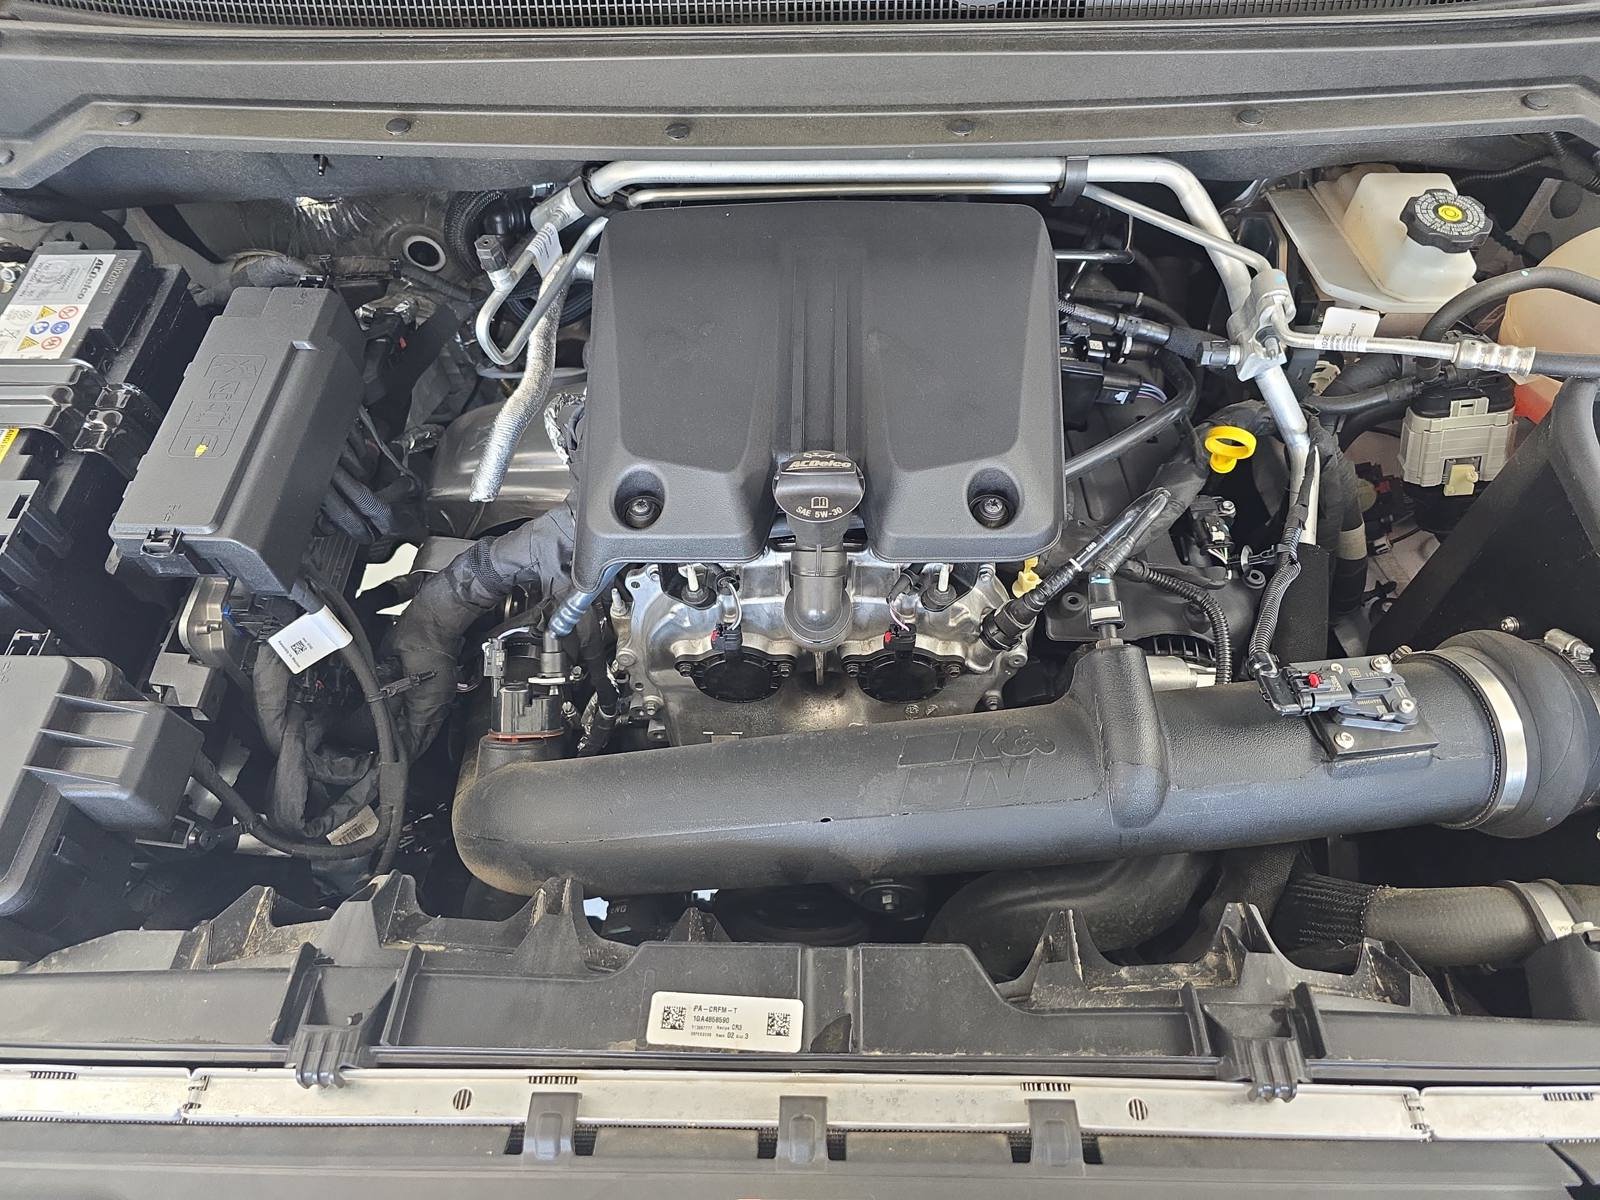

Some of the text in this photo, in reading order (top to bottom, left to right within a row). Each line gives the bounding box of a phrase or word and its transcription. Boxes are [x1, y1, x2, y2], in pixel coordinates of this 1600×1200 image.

[77, 258, 105, 299] ACDelco
[787, 460, 852, 470] ACDelco
[795, 505, 843, 518] SAE 5W-30
